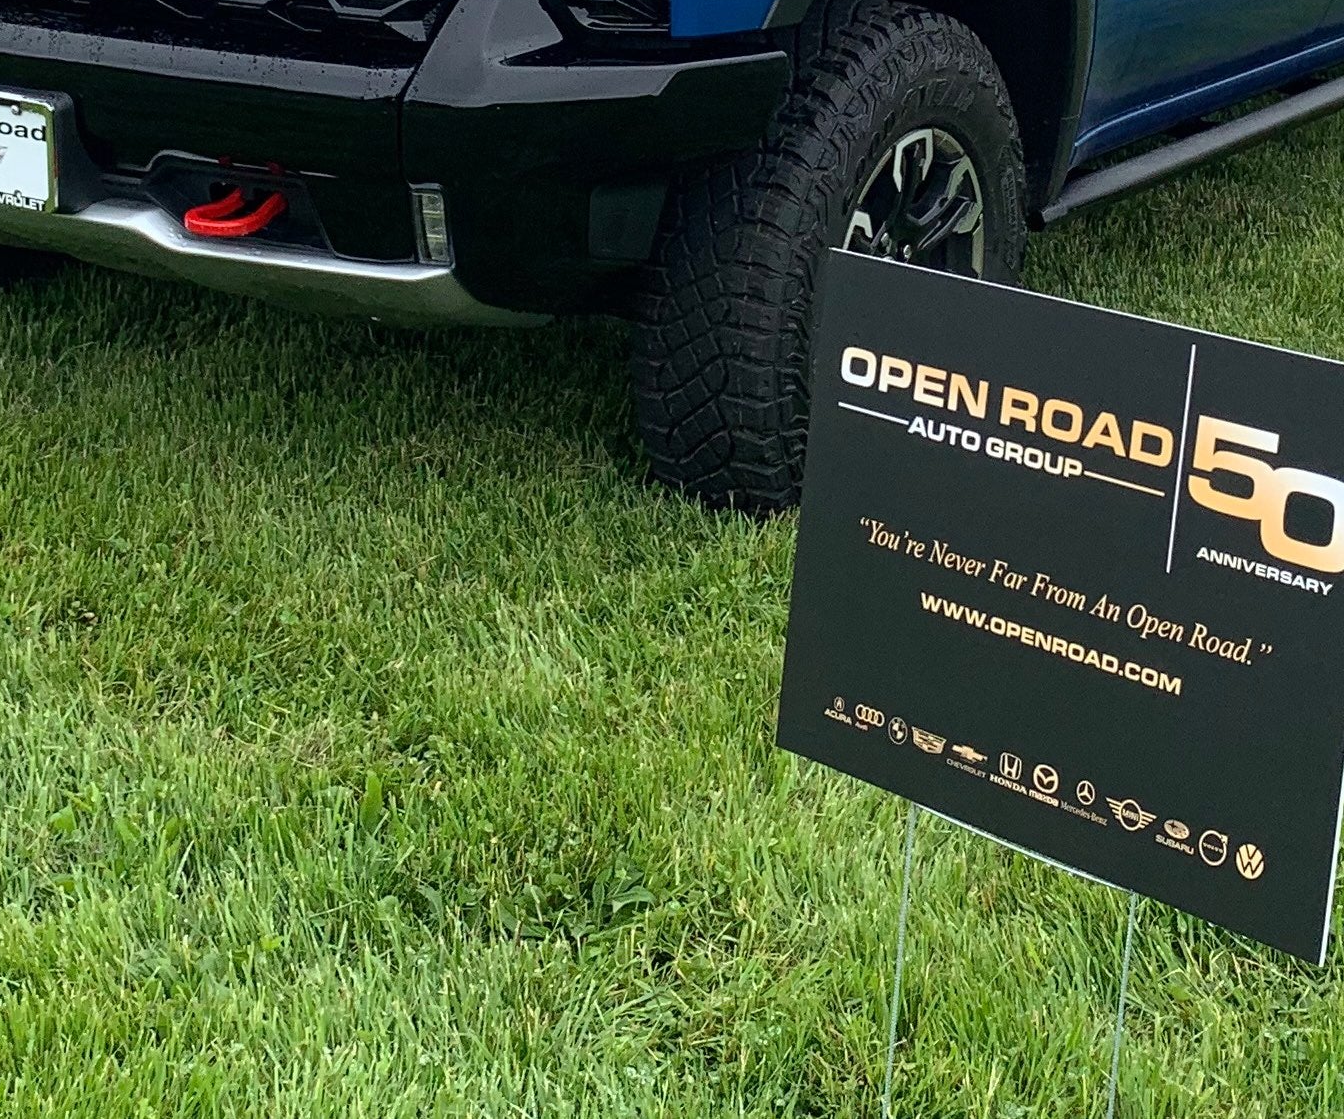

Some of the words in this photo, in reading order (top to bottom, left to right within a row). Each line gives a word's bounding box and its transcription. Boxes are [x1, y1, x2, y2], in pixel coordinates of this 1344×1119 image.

[840, 346, 990, 420] OPEN
[999, 386, 1174, 468] ROAD
[907, 416, 982, 453] AUTO
[984, 436, 1083, 479] GROUP
[927, 539, 987, 577] Never
[987, 558, 1028, 591] Far
[1030, 572, 1087, 612] From
[1089, 593, 1121, 623] An
[1126, 603, 1185, 640] Open
[1196, 546, 1334, 597] ANNIVERSARY
[920, 591, 1182, 696] WWW.OPENROAD.COM
[823, 708, 853, 726] ACURA
[945, 757, 987, 779] CHEVROLET
[989, 772, 1028, 796] HONDA
[1060, 799, 1108, 827] Mercedes-Benz
[1155, 833, 1196, 856] SUBARU
